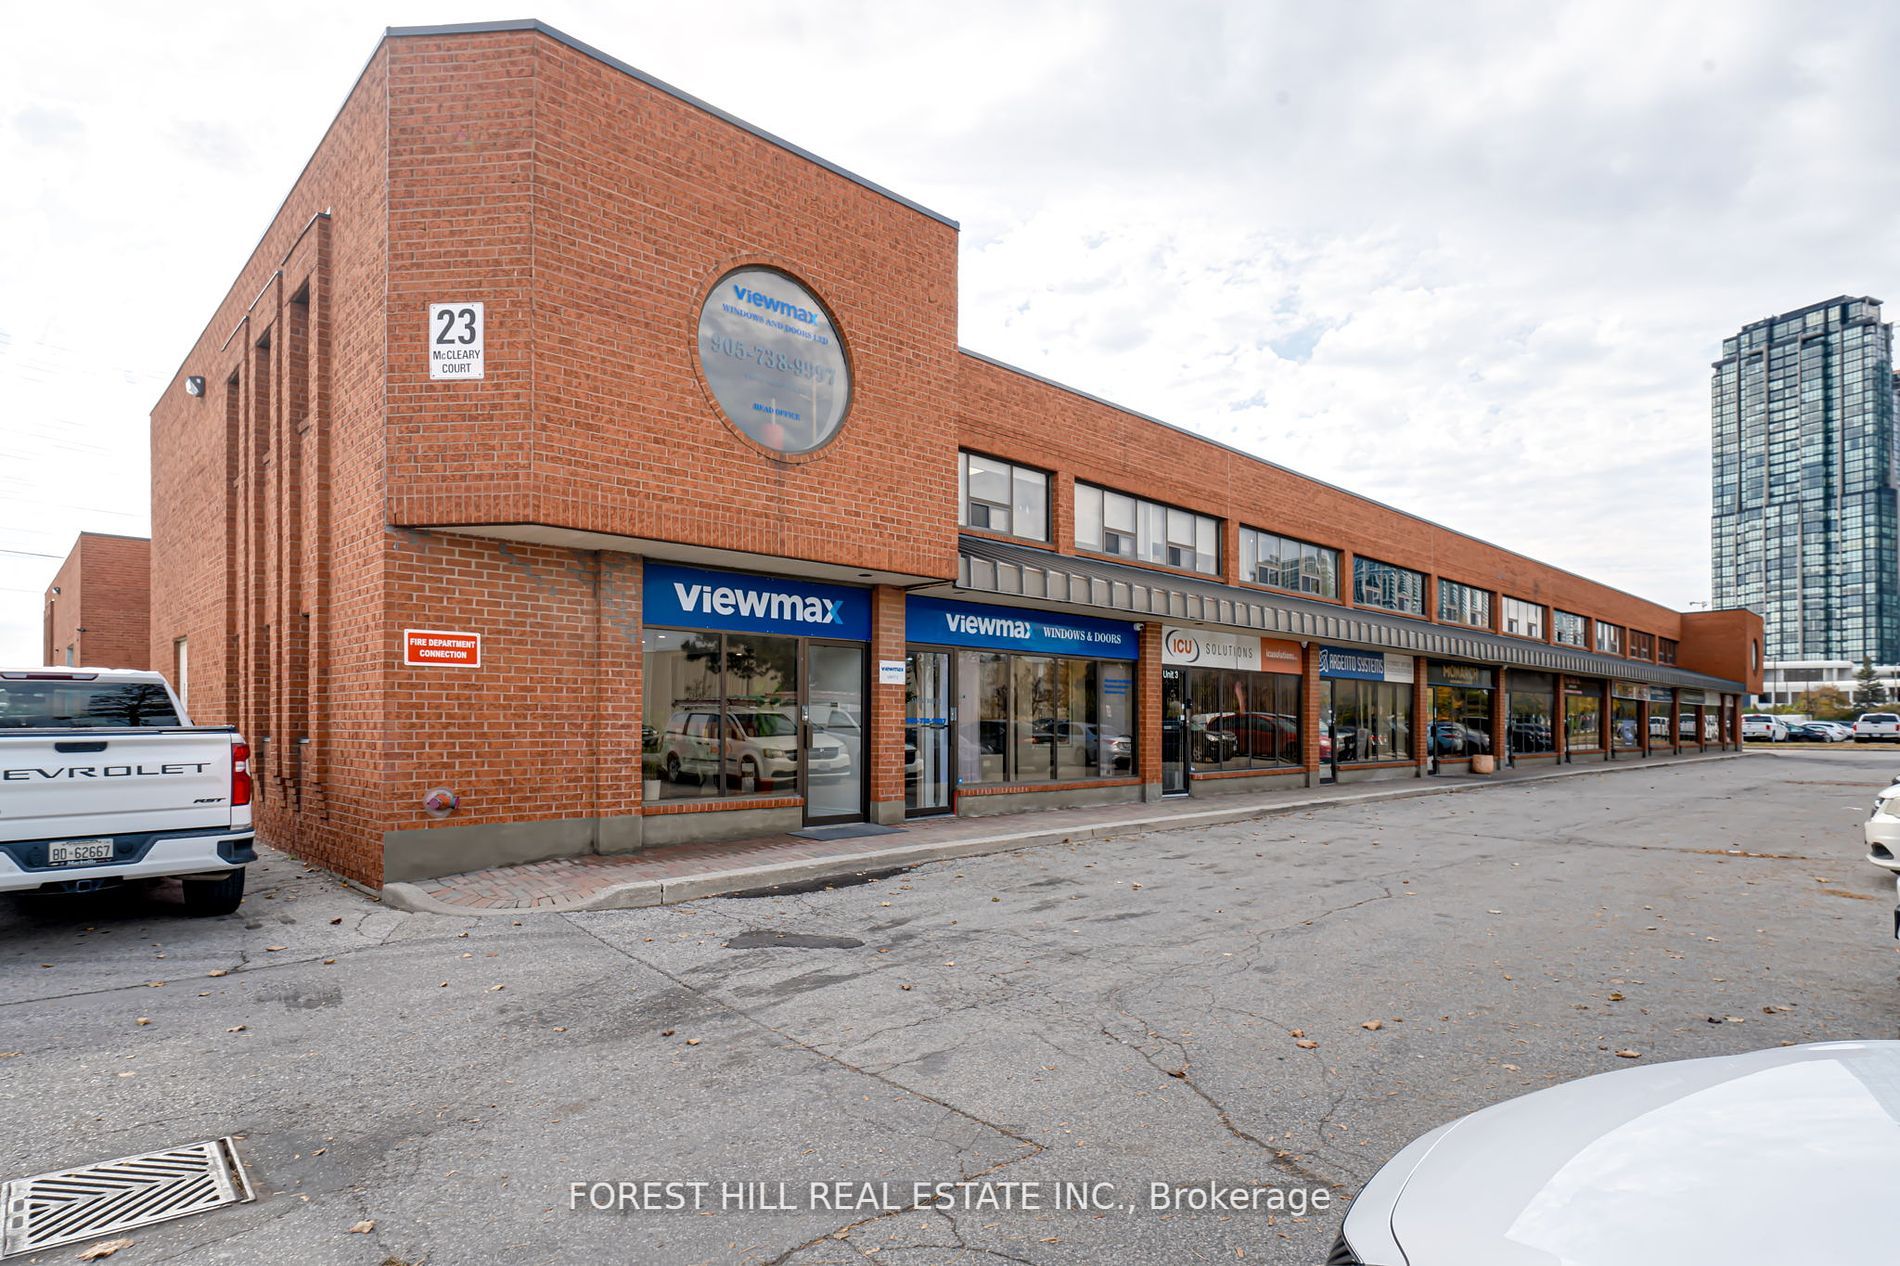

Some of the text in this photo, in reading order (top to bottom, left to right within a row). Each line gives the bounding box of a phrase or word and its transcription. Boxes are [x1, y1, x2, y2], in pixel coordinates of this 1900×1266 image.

[733, 284, 818, 326] viewmax
[436, 308, 476, 345] 23
[722, 303, 829, 346] WINDOWS AND DOORS LTD
[433, 350, 480, 360] McCLEARY
[442, 363, 472, 374] COURT
[753, 402, 801, 422] HEAD OFFICE
[673, 582, 844, 625] viewmax
[945, 613, 1122, 645] viewmax WINDOWS & DOORS
[410, 637, 476, 649] FIRE DEPARTMENT
[1173, 638, 1253, 659] ICU SOLUTIONS
[419, 649, 467, 659] CONNECTION
[1329, 653, 1356, 672] ARGENTO
[1162, 669, 1175, 679] Unit
[3, 762, 211, 781] EVROLET
[74, 845, 111, 859] 62667
